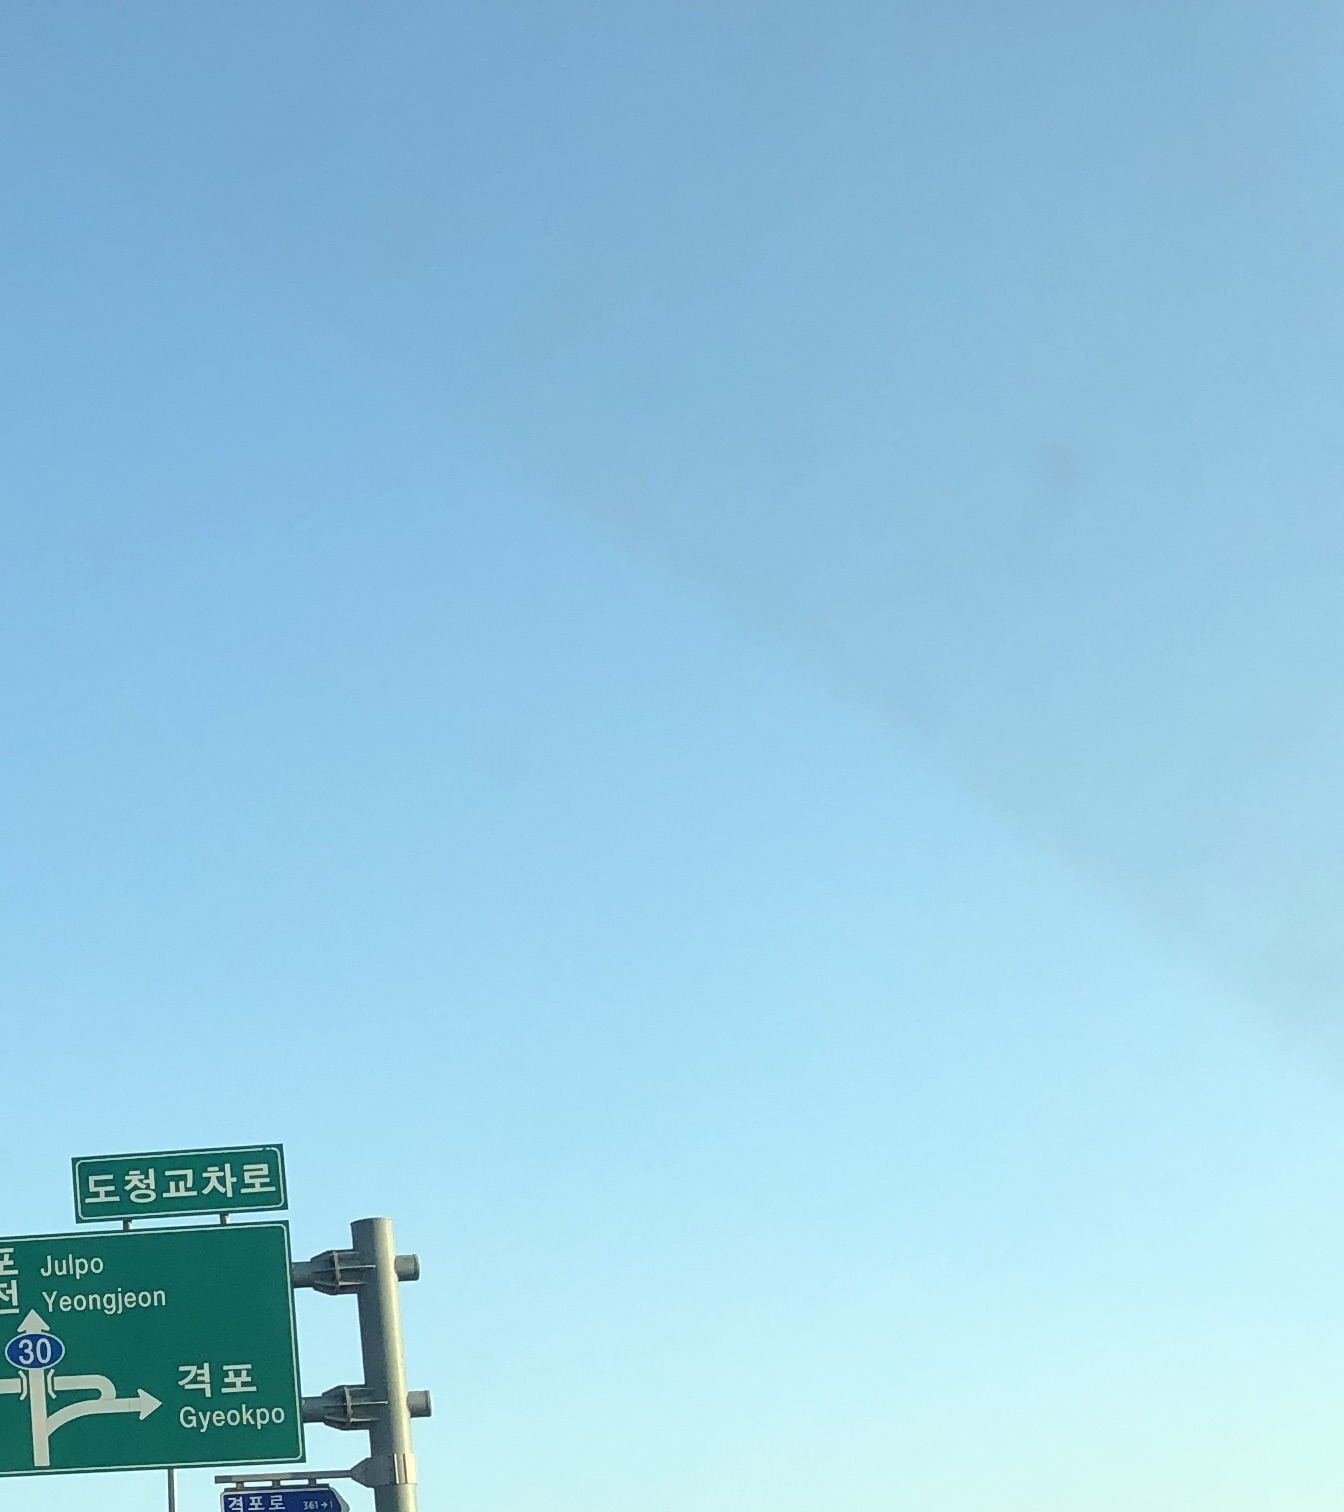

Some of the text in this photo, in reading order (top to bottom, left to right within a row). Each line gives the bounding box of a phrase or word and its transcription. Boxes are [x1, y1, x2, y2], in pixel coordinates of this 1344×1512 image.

[84, 1162, 276, 1204] 도청교차로
[40, 1253, 104, 1280] Julpo
[41, 1287, 166, 1314] Yeongjeon
[18, 1337, 52, 1365] 30
[177, 1362, 257, 1398] 격포
[179, 1403, 285, 1433] Gyeokpo
